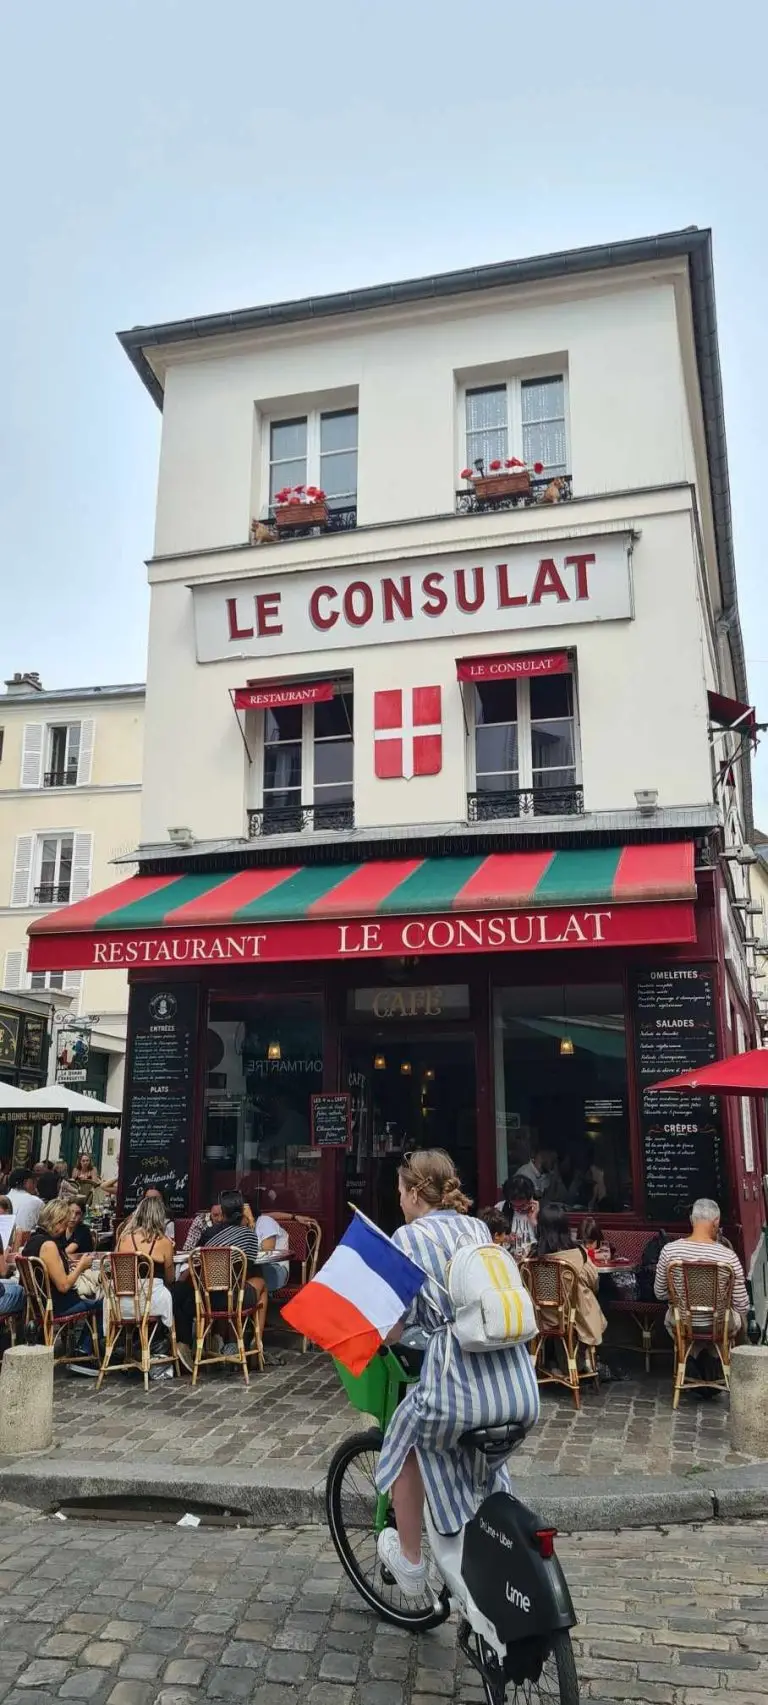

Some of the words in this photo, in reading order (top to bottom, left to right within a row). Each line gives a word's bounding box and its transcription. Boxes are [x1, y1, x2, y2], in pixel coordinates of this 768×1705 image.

[226, 592, 283, 641] LE
[309, 553, 595, 632] CONSULAT
[470, 665, 484, 675] LE
[490, 659, 553, 674] CONSULAT
[250, 688, 318, 704] RESTAURANT
[93, 935, 266, 963] RESTAURANT
[338, 924, 383, 953] LE
[401, 912, 611, 949] CONSULAT
[650, 970, 698, 980] OMELETTES
[656, 1020, 695, 1028] SALADES
[664, 1124, 698, 1132] CRÊPES
[500, 1532, 513, 1548] Uber
[506, 1581, 531, 1613] Lime
